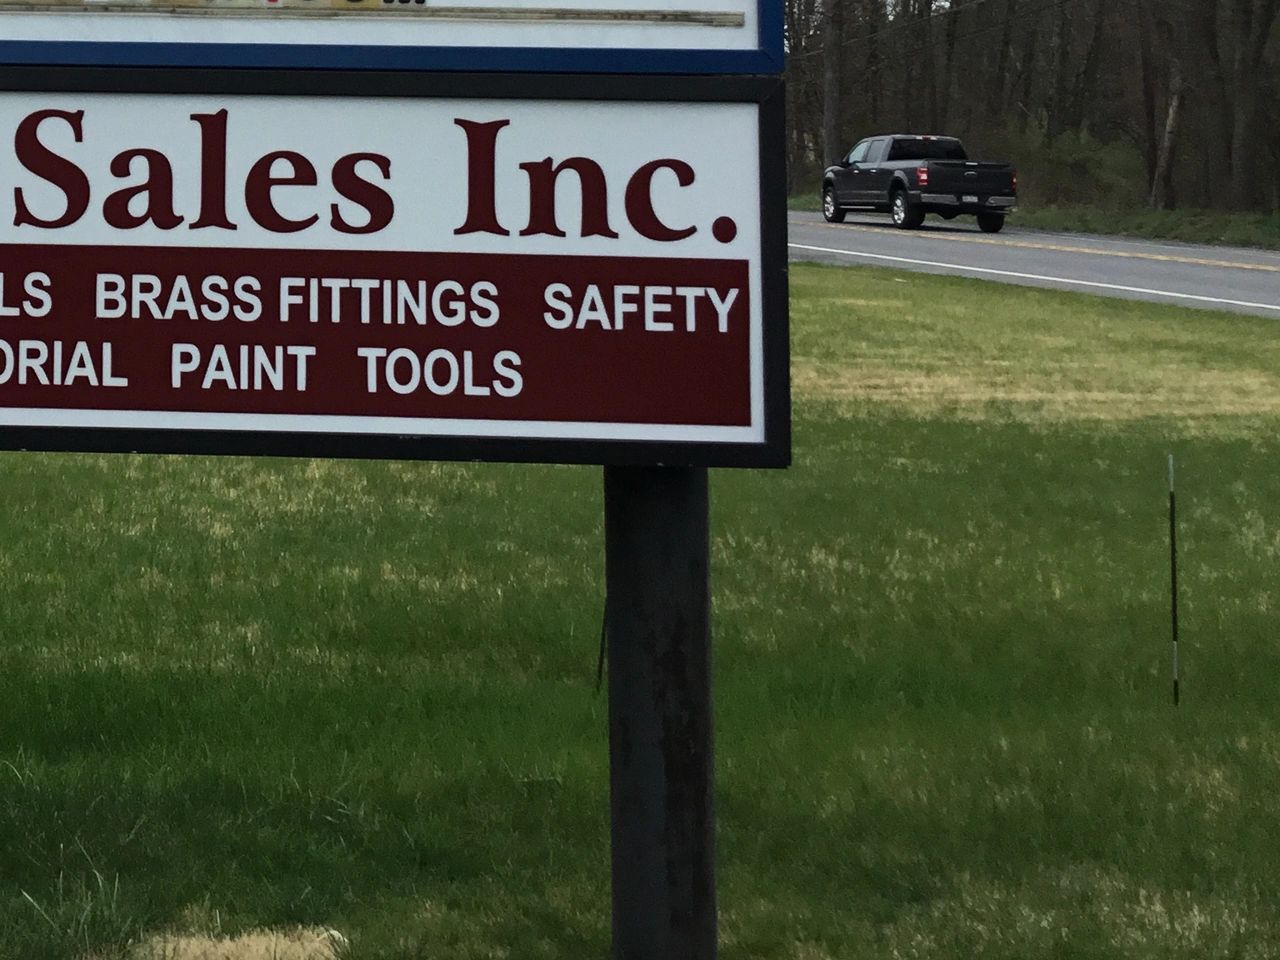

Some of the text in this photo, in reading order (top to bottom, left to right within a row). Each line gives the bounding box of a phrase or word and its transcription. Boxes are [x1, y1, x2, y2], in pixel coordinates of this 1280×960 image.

[14, 108, 396, 235] Sales
[453, 118, 739, 244] Inc.
[95, 273, 263, 323] BRASS
[279, 277, 501, 328] FITTINGS
[544, 284, 740, 333] SAFETY
[170, 344, 317, 391] PAINT
[357, 347, 524, 398] TOOLS
